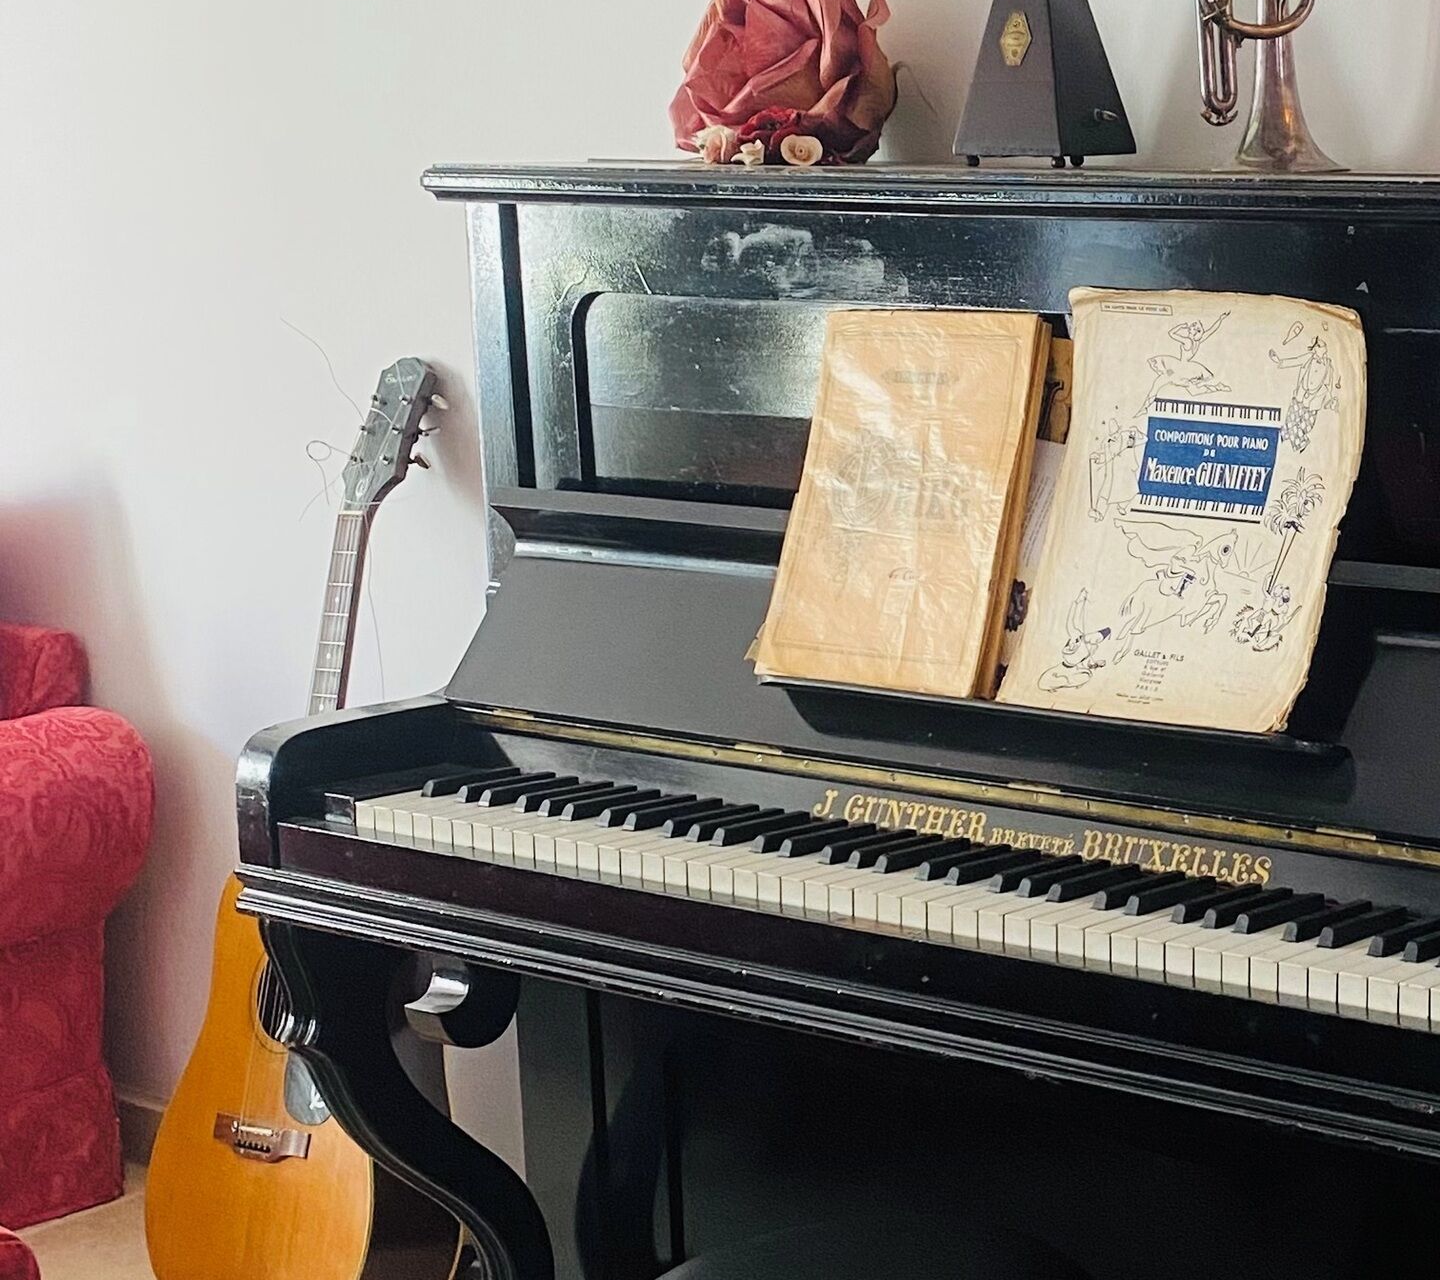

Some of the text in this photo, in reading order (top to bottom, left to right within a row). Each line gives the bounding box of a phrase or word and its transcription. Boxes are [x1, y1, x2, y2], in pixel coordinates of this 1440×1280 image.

[1154, 429, 1269, 451] COMPOSITIONS POUR PIANO
[1203, 448, 1216, 457] DE
[1143, 456, 1272, 492] Maxence GUENIFFEY
[1169, 653, 1185, 662] FILS
[812, 789, 839, 819] J.
[843, 794, 988, 844] GUNTHER
[1078, 829, 1272, 887] BRUXELLES
